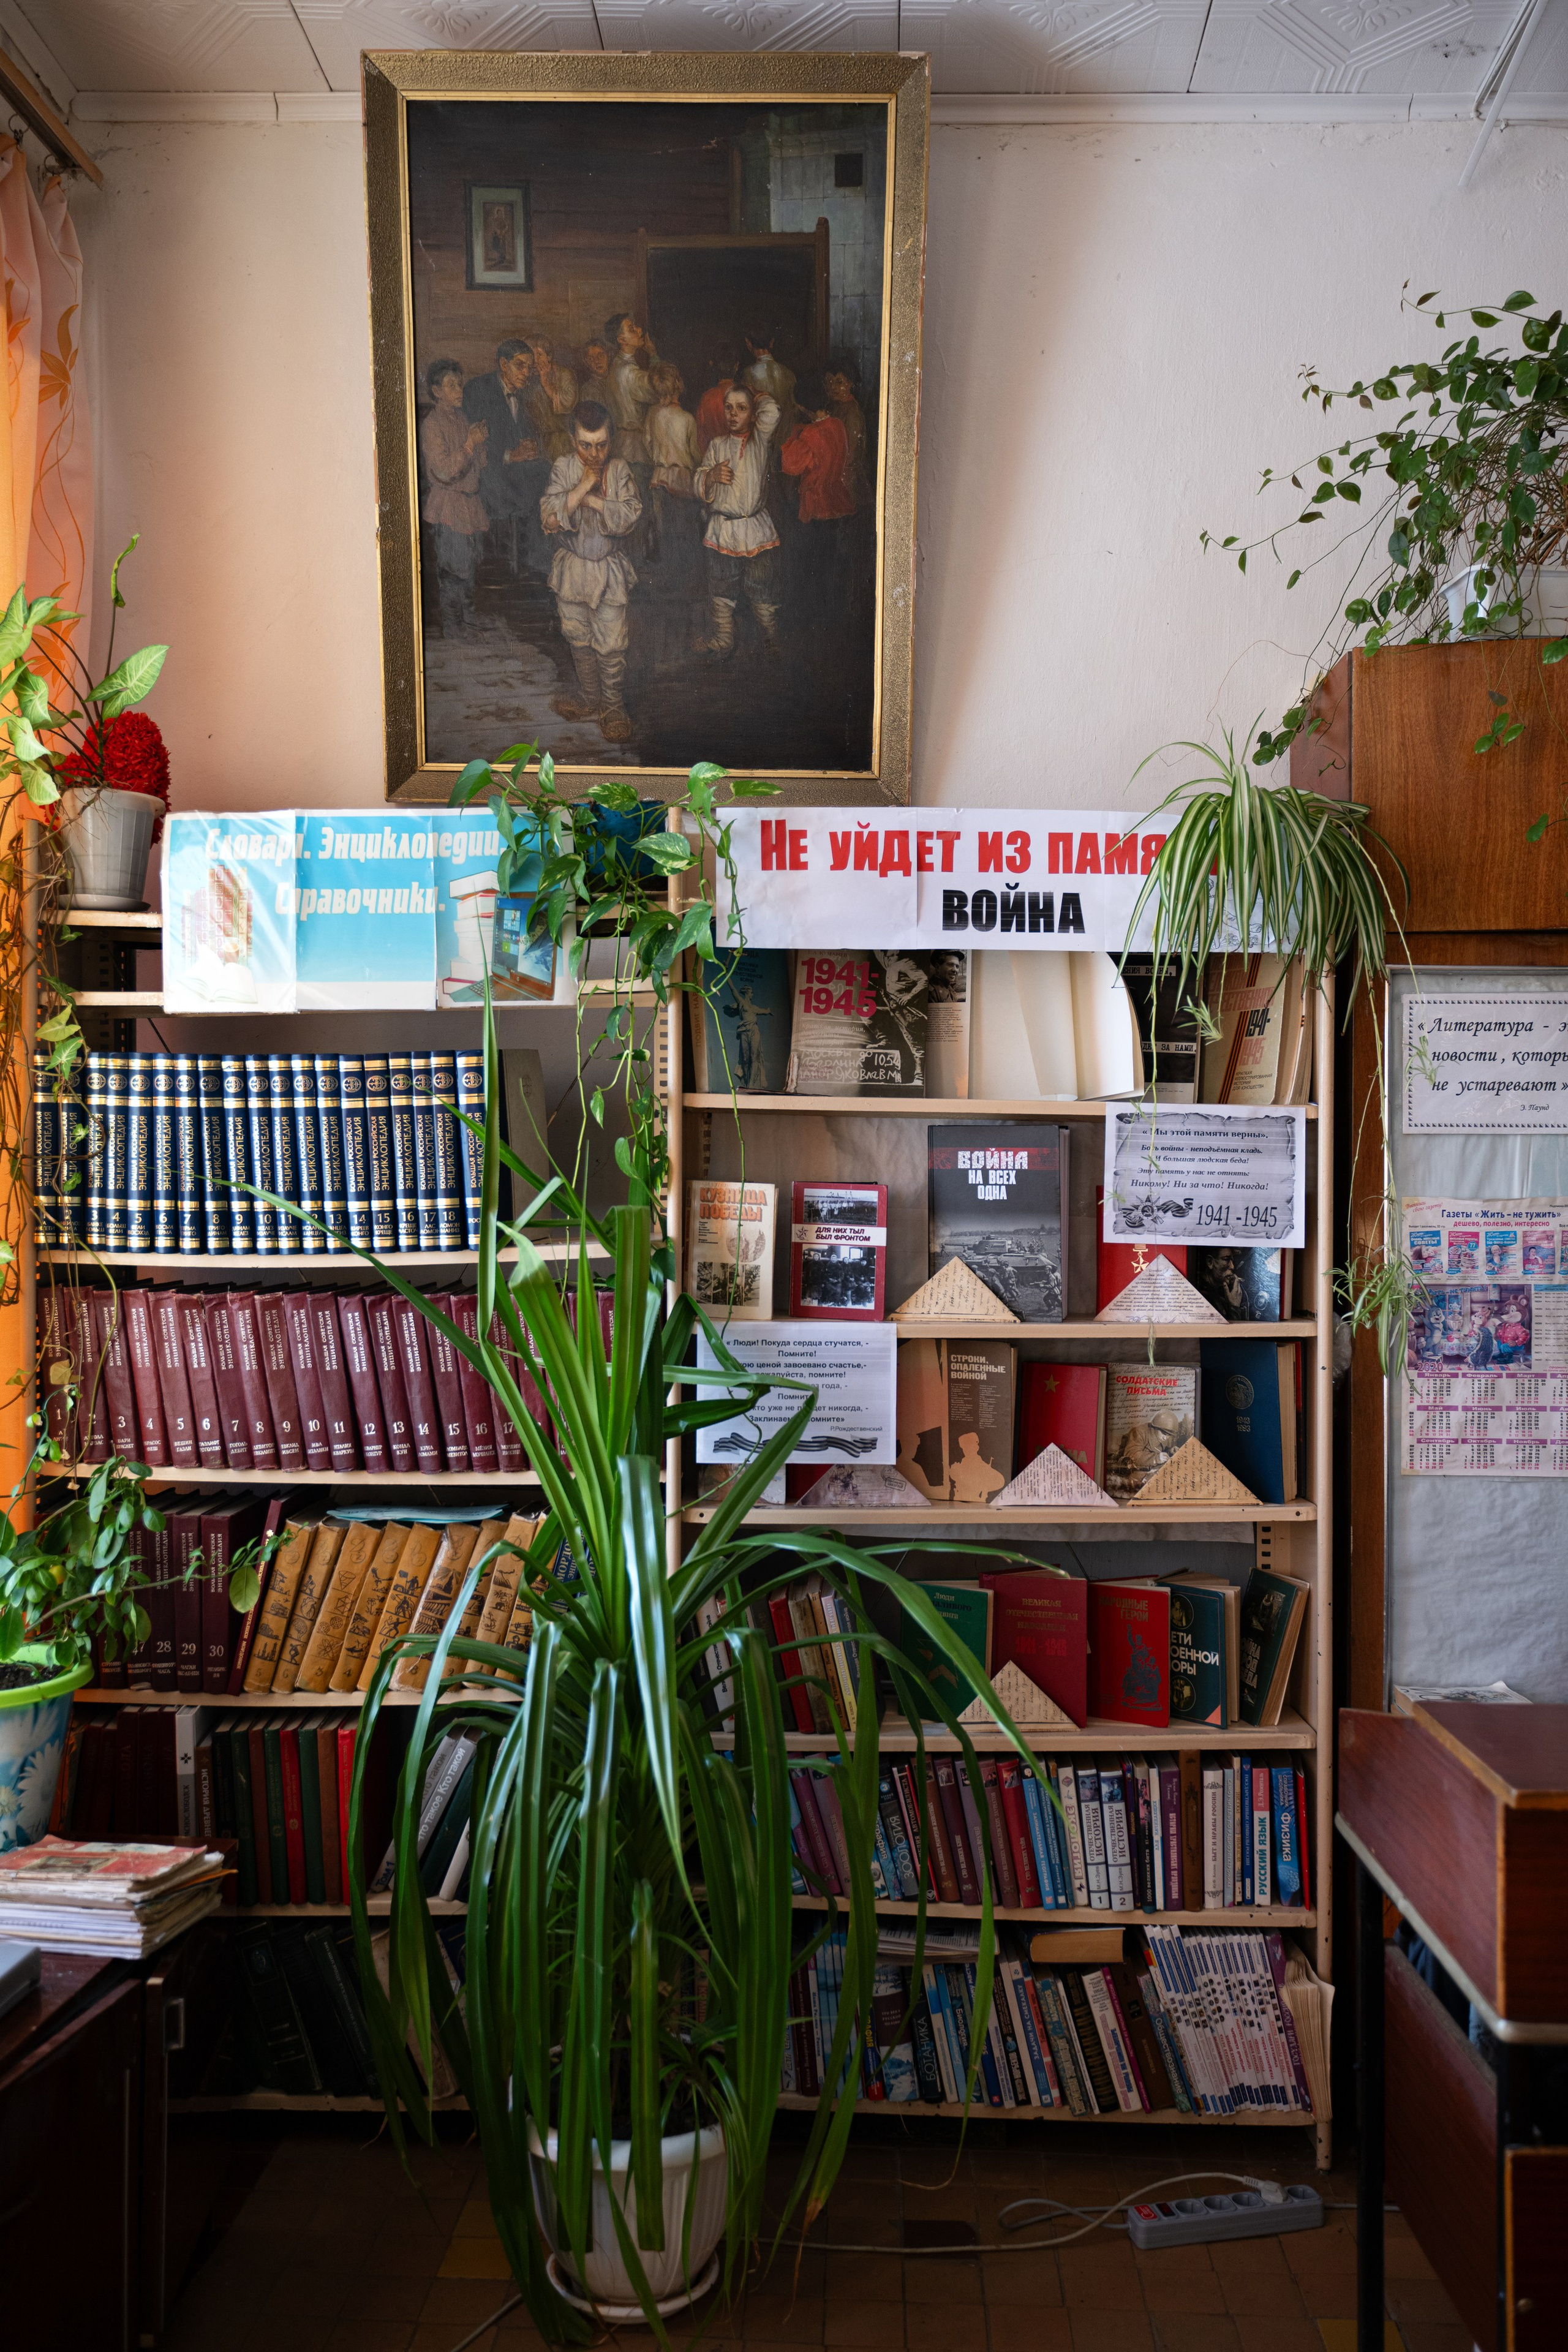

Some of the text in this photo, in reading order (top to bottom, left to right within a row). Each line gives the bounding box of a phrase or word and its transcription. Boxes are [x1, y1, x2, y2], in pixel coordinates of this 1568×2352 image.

[318, 826, 506, 864] Энциклопедии.
[829, 821, 962, 878] УЙДЕТ
[978, 830, 1031, 874] ИЗ
[1047, 832, 1174, 876] ПАМЯ
[274, 881, 446, 921] Справочники.
[942, 883, 1086, 933] ВОЙНА
[801, 957, 879, 987] 1941-
[799, 987, 876, 1017] 1945
[1245, 1008, 1271, 1037] 1941-
[1427, 1018, 1534, 1036] Литература
[1238, 1038, 1266, 1066] 1945
[1431, 1051, 1497, 1061] новости
[1432, 1080, 1556, 1096] не устаревают
[163, 1115, 172, 1191] ЭНЦИКЛОПЕДИЯ
[354, 1117, 364, 1191] ЭНЦИКЛОПЕДИЯ
[379, 1116, 390, 1191] ЭНЦИКЛОПЕДИЯ
[957, 1147, 1028, 1169] ВОЙНА
[968, 1170, 1016, 1185] НА ВСЕХ
[1131, 1179, 1170, 1188] Никому!
[699, 1187, 768, 1206] КУЗНИЦА
[978, 1185, 1007, 1200] ОДНА
[112, 1212, 120, 1221] 4
[135, 1213, 142, 1223] 5
[159, 1213, 167, 1223] 6
[353, 1215, 366, 1224] 14
[377, 1213, 390, 1223] 15
[699, 1203, 763, 1221] ПОБЕДЫ
[1196, 1204, 1231, 1227] 1941
[1441, 1210, 1472, 1218] Газеты
[139, 1308, 150, 1367] ЭНЦИКЛОПЕДИЯ
[167, 1308, 179, 1367] ЭНЦИКЛОПЕДИЯ
[951, 1354, 989, 1364] СТРОКИ,
[1418, 1362, 1443, 1372] 2020
[951, 1363, 1006, 1373] ОПАЛЕННЫЕ
[951, 1370, 987, 1381] ВОЙНОЙ
[1115, 1375, 1178, 1387] СОЛДАТСКИЕ
[1127, 1386, 1166, 1396] ПИСЬМА
[118, 1416, 126, 1428] 3
[146, 1418, 153, 1429] 4
[934, 1593, 955, 1602] Люди
[1022, 1599, 1061, 1607] ВЕЛИКАЯ
[1098, 1596, 1148, 1610] НАРОДНЫЕ
[1005, 1609, 1079, 1620] ОТЕЧЕСТВЕННАЯ
[1120, 1609, 1148, 1622] ГЕРОИ
[156, 1641, 172, 1653] 28
[182, 1643, 196, 1654] 29
[209, 1645, 224, 1657] 30
[1085, 1804, 1095, 1861] ОТЕЧЕСТВЕННАЯ
[1091, 1807, 1103, 1856] ИСТОРИЯ
[1108, 1806, 1118, 1863] ОТЕЧЕСТВЕННАЯ
[1115, 1809, 1126, 1858] ИСТОРИЯ
[1280, 1812, 1292, 1861] Физика
[889, 1815, 914, 1879] ЗООЛОГИЯ
[1259, 1850, 1267, 1895] РУССКИЙ
[918, 2016, 936, 2081] БОТАНИКА
[1155, 2018, 1183, 2094] Обществознание
